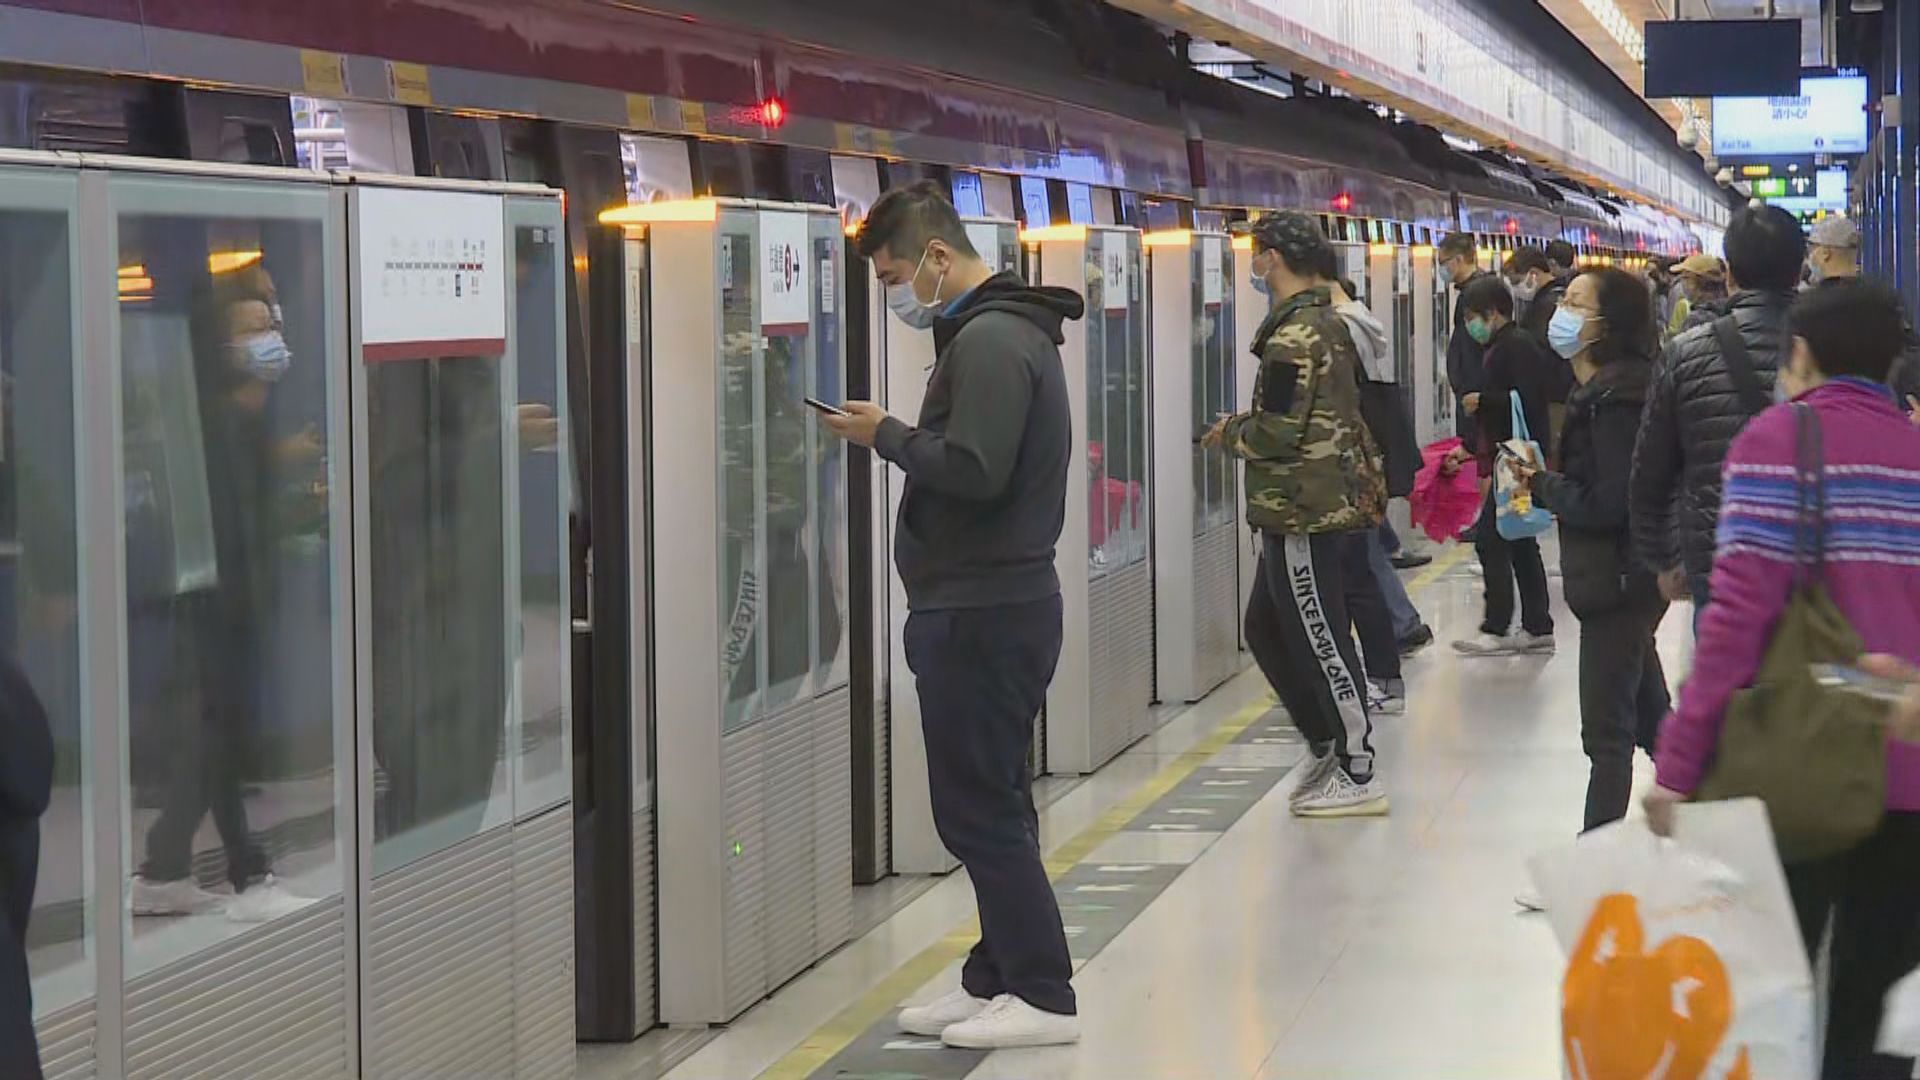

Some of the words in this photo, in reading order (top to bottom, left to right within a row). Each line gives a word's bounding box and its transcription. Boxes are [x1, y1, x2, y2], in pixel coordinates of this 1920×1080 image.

[1837, 67, 1858, 77] 10:01
[1293, 565, 1321, 620] SINCE
[1310, 622, 1336, 661] DAY
[1327, 665, 1355, 701] ONE
